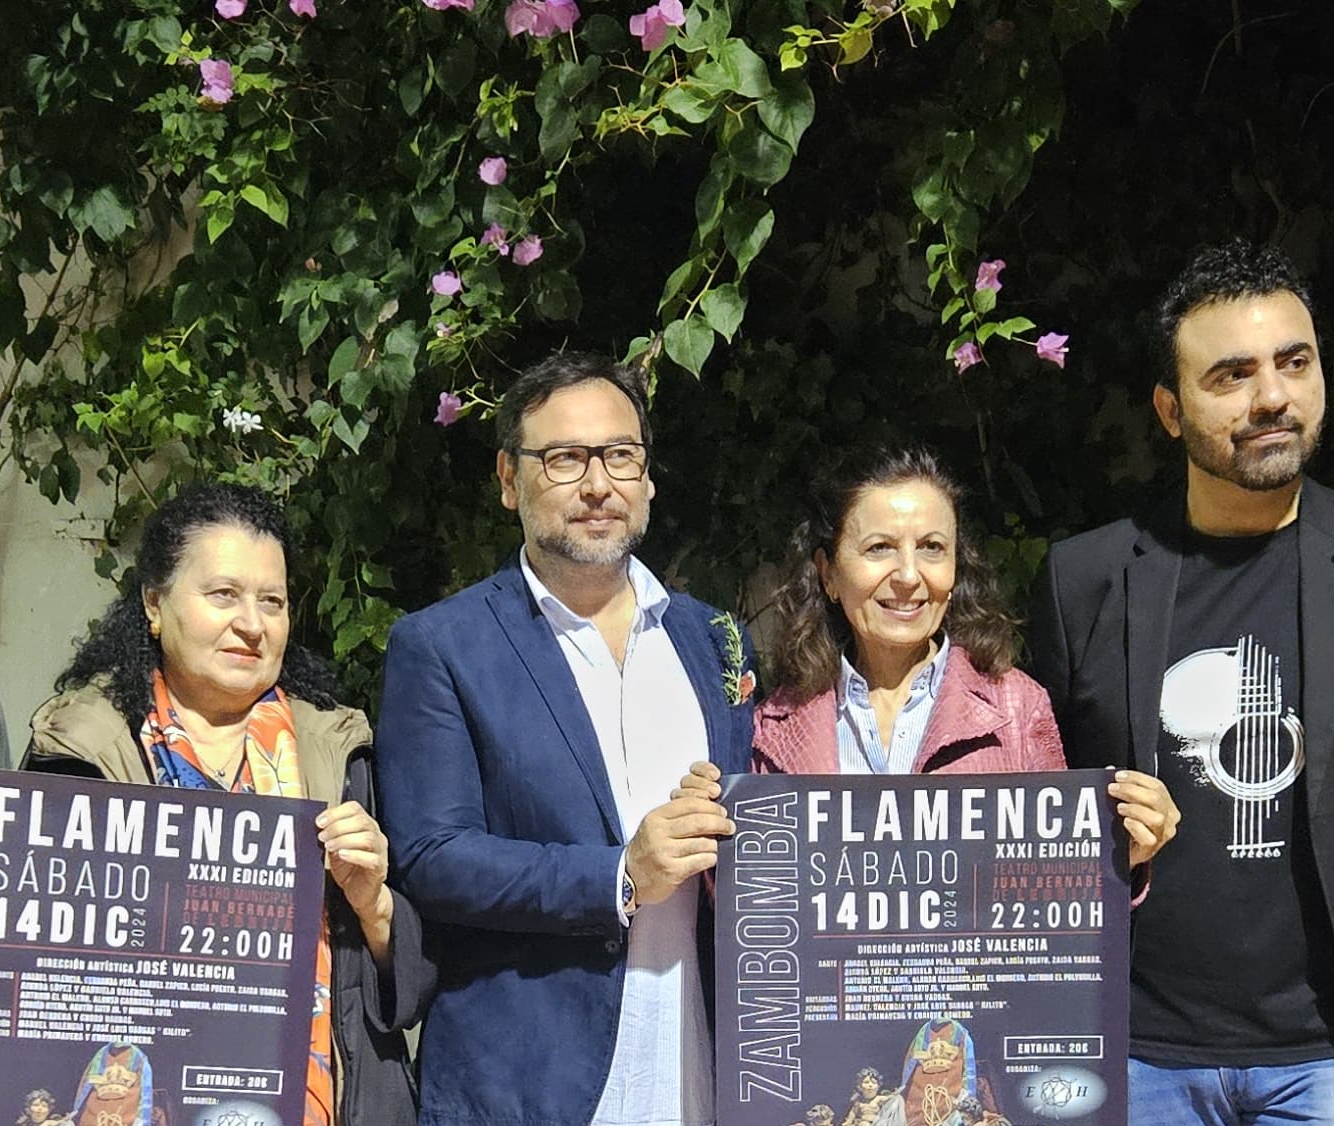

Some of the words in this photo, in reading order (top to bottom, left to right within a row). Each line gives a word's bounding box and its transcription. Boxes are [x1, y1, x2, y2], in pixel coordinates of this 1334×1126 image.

[808, 787, 1101, 842] FLAMENCA
[995, 842, 1032, 859] XXXI
[1039, 839, 1101, 858] EDICIÓN
[188, 863, 227, 882] XXXI
[232, 867, 295, 888] EDICIÓN
[810, 846, 958, 886] SÁBADO
[994, 864, 1037, 876] TEATRO
[1041, 862, 1103, 875] MUNICIPAL
[185, 884, 230, 898] TEATRO
[994, 876, 1028, 889] JUAN
[1036, 874, 1103, 888] BERNABÉ
[183, 900, 220, 914] JUAN
[227, 901, 295, 919] BERNABÉ
[943, 891, 957, 928] 2024
[991, 902, 1103, 929] 22:00H
[130, 908, 147, 948] 2024
[180, 926, 293, 960] 22:00H
[734, 791, 802, 1102] ZAMBOMBA
[858, 943, 902, 954] DIRECCIÓN
[905, 942, 949, 953] ARTÍSTICA
[951, 937, 981, 952] JOSÉ
[986, 938, 1048, 952] VALENCIA
[36, 957, 85, 971] DIRECCIÓN
[87, 960, 134, 974] ARTÍSTICA
[135, 960, 168, 976] JOSÉ
[172, 962, 235, 980] VALENCIA
[1018, 1043, 1065, 1054] ENTRADA:
[196, 1074, 244, 1087] ENTRADA:
[1026, 1086, 1036, 1098] E
